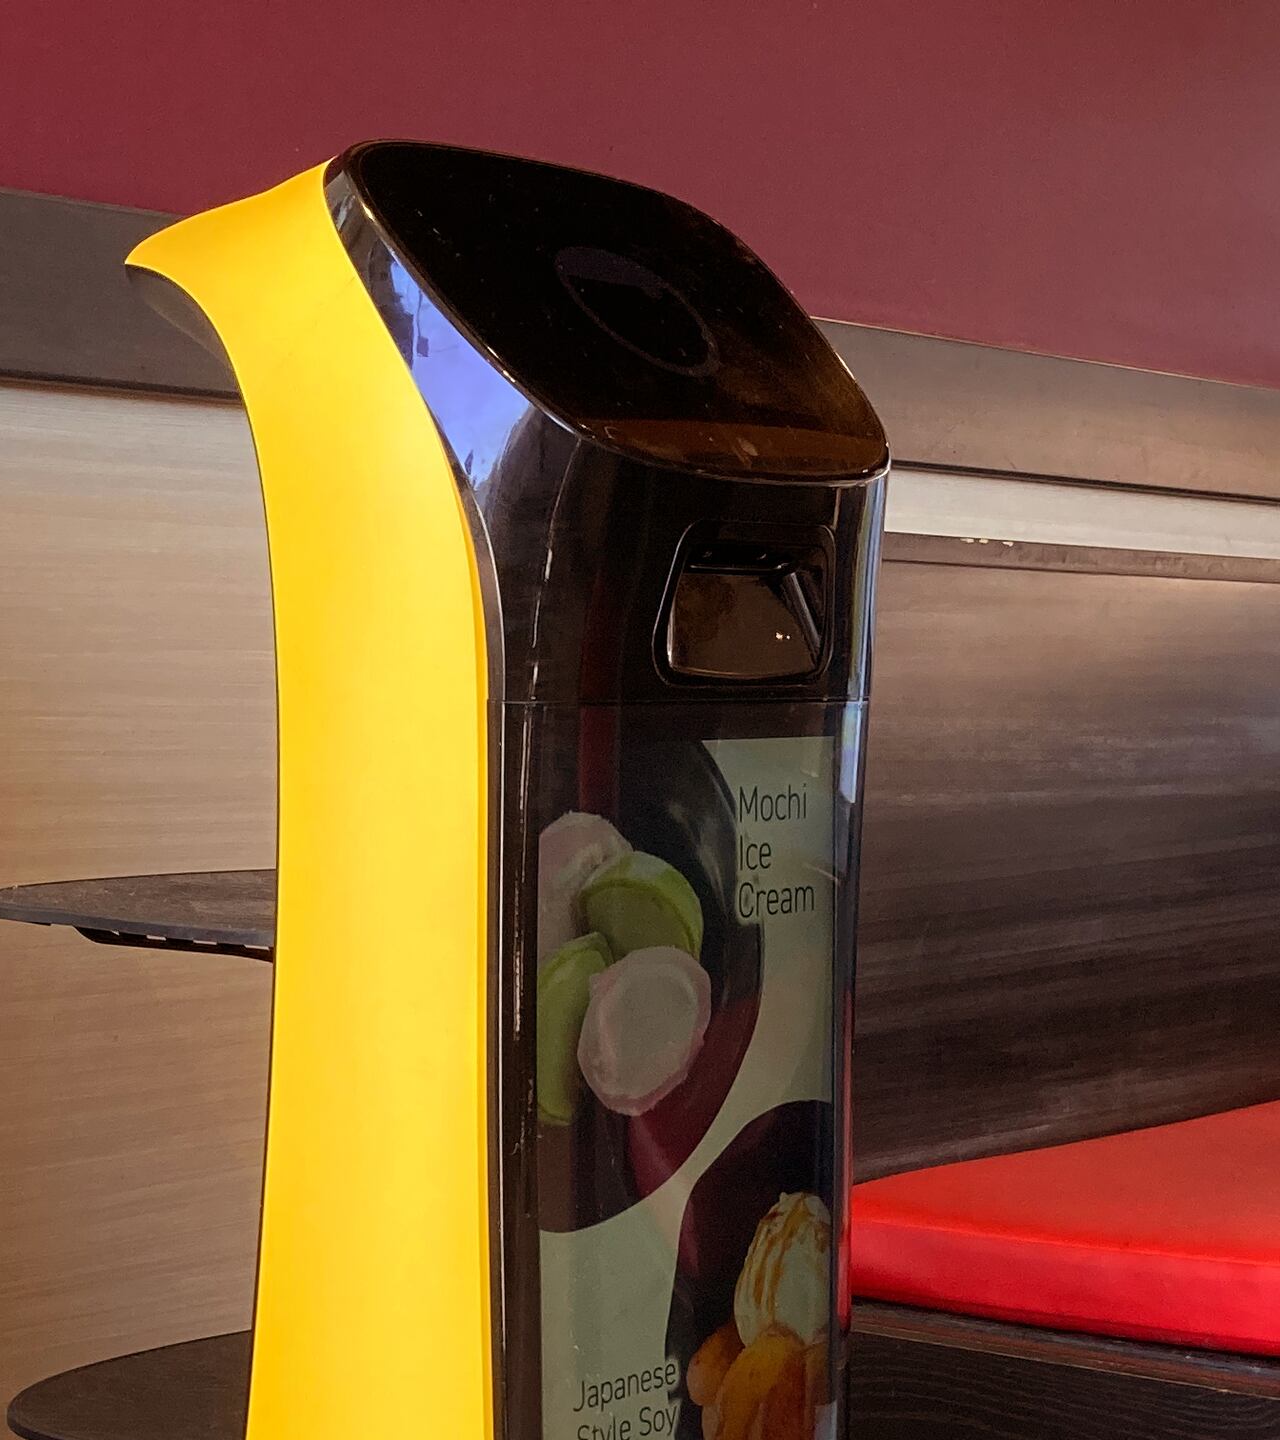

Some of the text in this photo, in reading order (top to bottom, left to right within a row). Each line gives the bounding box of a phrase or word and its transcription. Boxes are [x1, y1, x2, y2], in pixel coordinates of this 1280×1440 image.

[739, 783, 807, 823] Mochi
[740, 835, 772, 871] Ice
[738, 882, 815, 918] Cream
[572, 1363, 676, 1412] Japanese
[639, 1405, 678, 1437] Soy
